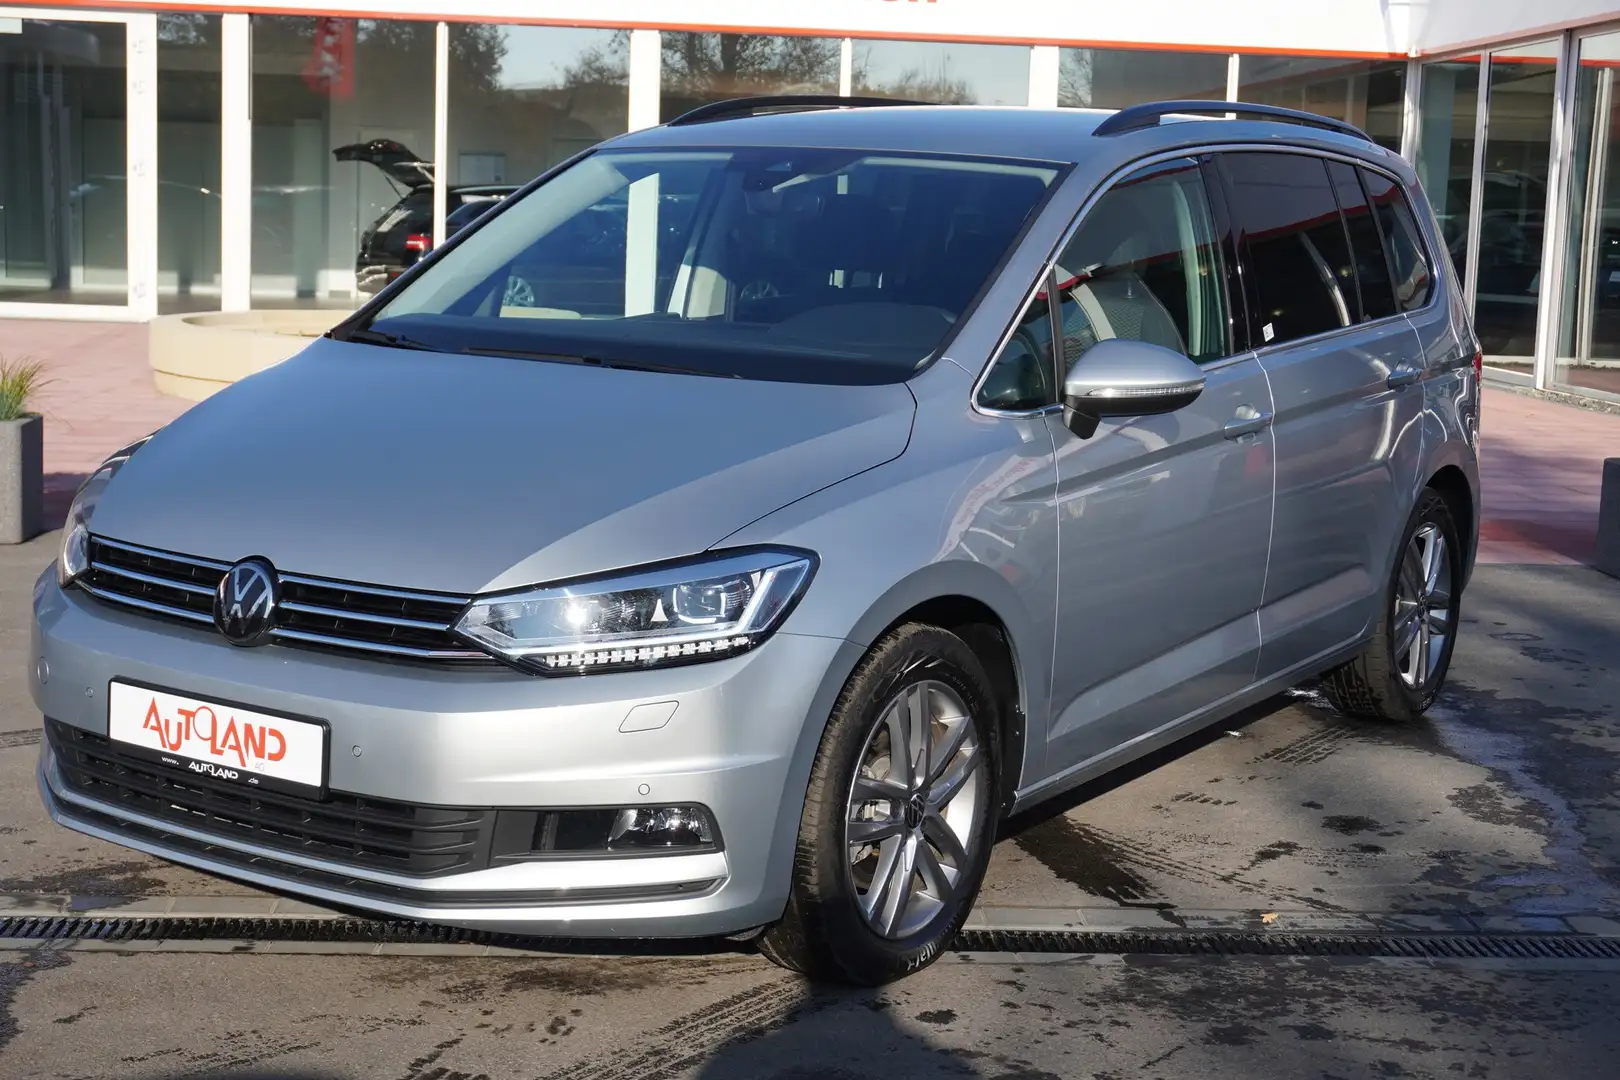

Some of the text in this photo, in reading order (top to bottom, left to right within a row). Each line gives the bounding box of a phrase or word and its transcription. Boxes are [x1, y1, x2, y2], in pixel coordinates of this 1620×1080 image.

[142, 697, 287, 767] AUTOLAND
[161, 756, 259, 785] www. AUTOLAND .de
